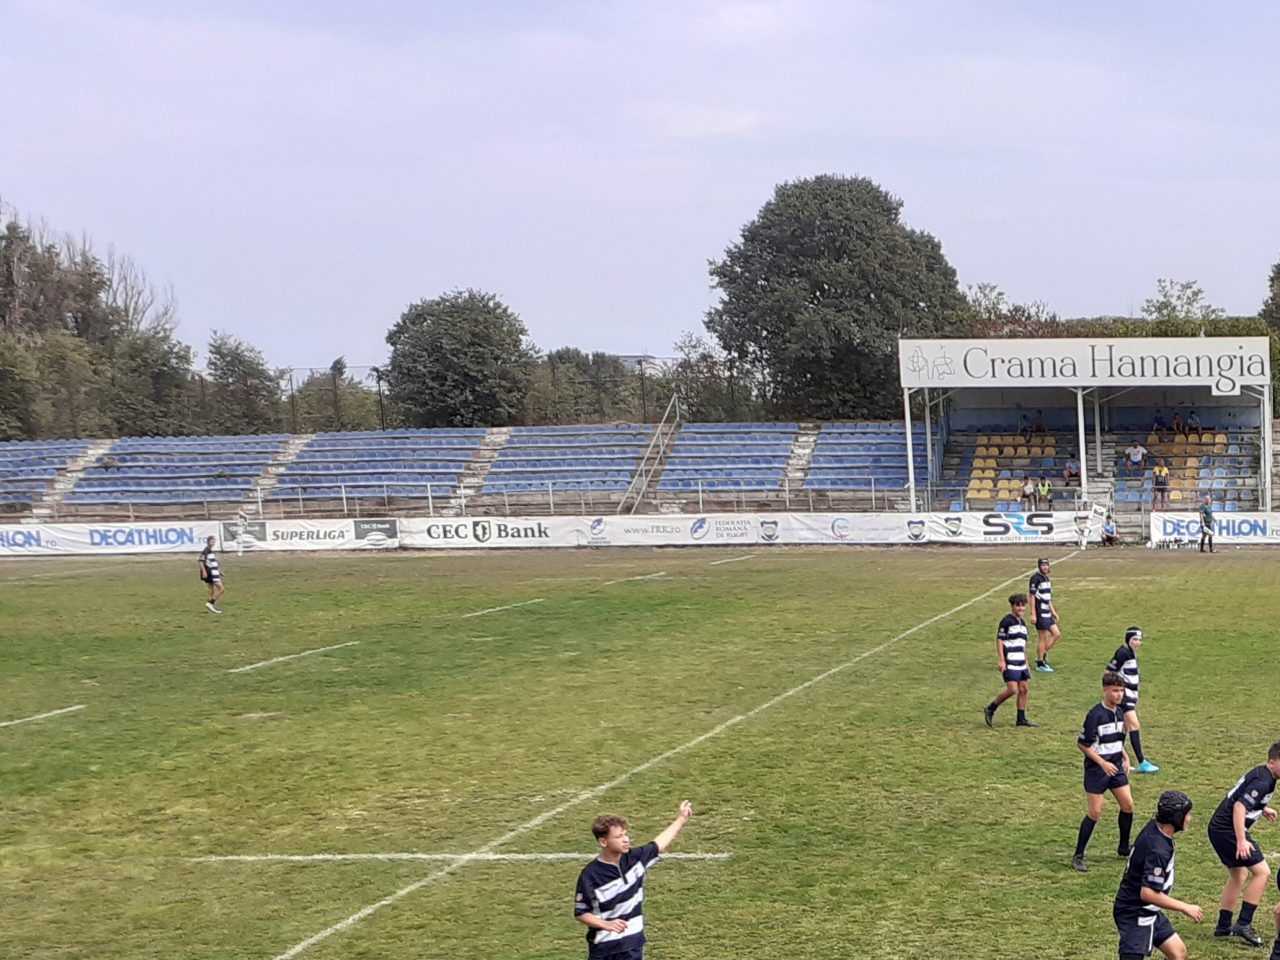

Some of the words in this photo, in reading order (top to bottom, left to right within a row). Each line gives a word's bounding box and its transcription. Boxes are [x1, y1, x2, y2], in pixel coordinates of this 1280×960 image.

[964, 347, 1077, 379] Crama
[1089, 344, 1266, 393] Hamangia
[426, 524, 468, 539] CEC
[496, 522, 550, 539] Bank
[983, 513, 1055, 536] SRS
